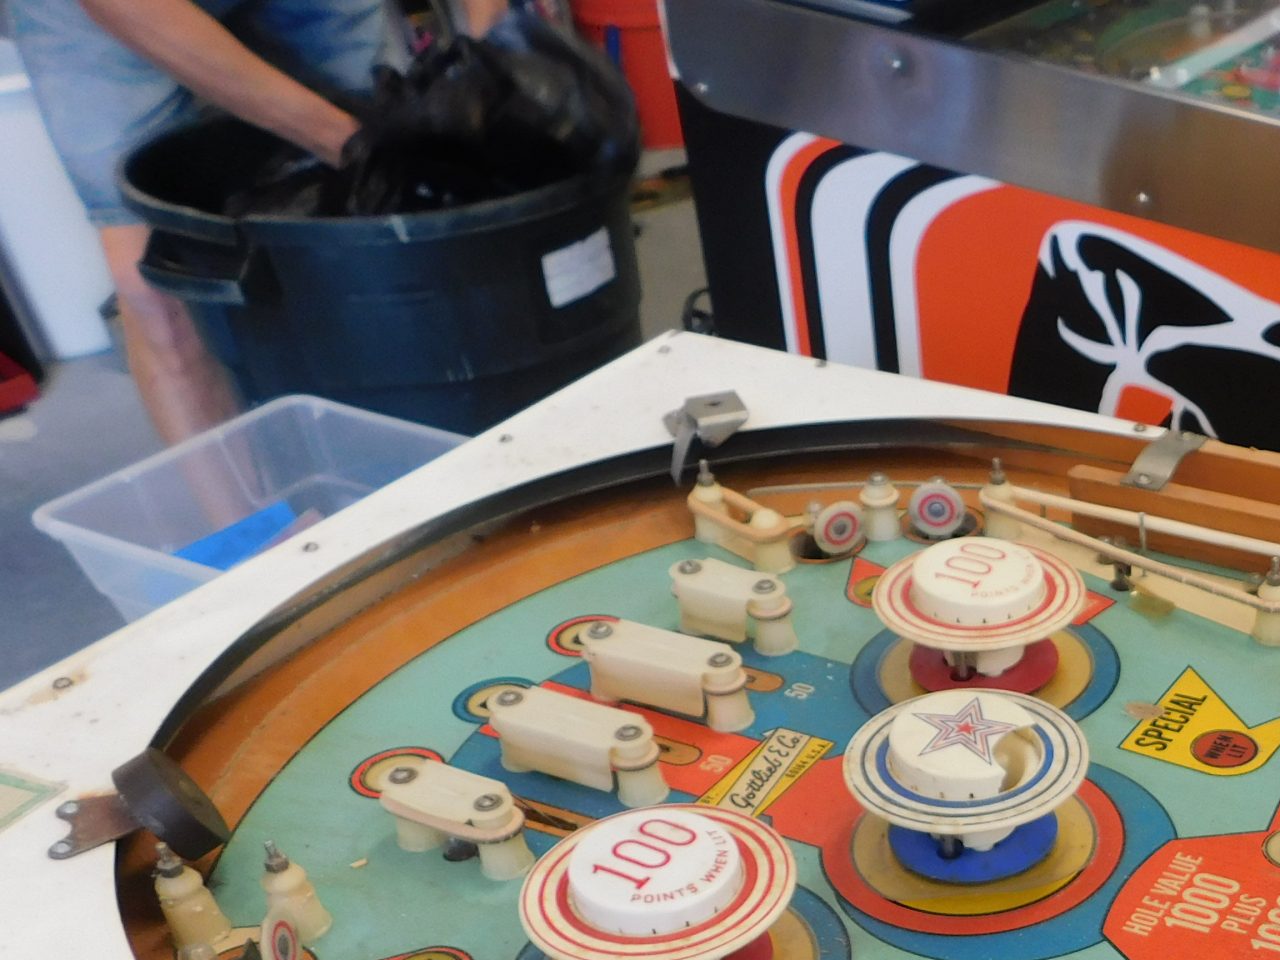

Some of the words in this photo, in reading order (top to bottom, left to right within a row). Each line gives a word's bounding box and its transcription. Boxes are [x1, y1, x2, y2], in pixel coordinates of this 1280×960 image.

[934, 542, 1007, 589] 100
[784, 682, 816, 700] 50
[1135, 693, 1208, 751] SPECIAL
[700, 754, 733, 774] 50
[1204, 733, 1233, 760] WHEN
[1226, 743, 1249, 759] LIT
[729, 756, 783, 809] Gottlieb
[592, 819, 698, 890] 100
[705, 829, 727, 847] LIT
[700, 849, 729, 884] WHEN
[630, 882, 699, 904] POINTS
[1122, 894, 1172, 937] HOLE
[1156, 851, 1204, 897] VALUE
[1163, 872, 1241, 934] 1000
[1220, 893, 1267, 935] PLUS
